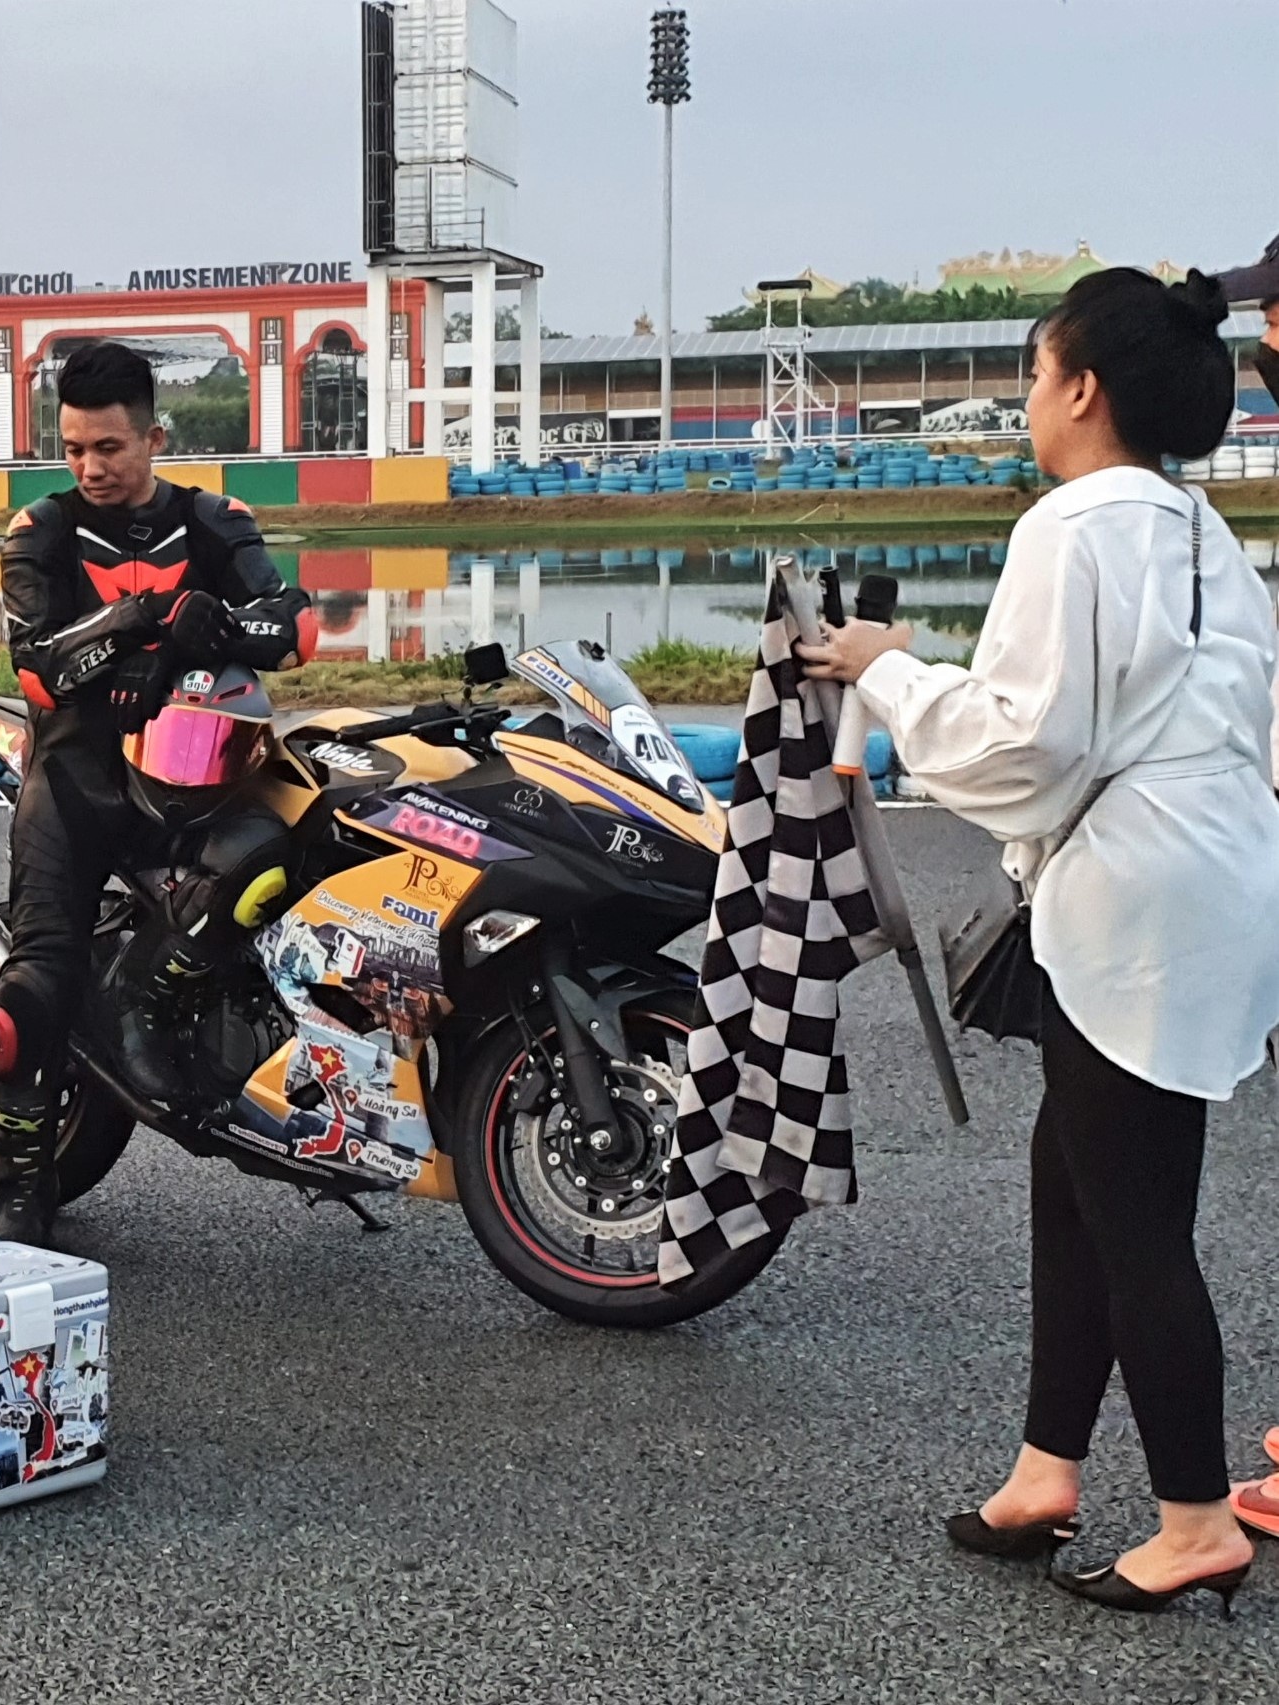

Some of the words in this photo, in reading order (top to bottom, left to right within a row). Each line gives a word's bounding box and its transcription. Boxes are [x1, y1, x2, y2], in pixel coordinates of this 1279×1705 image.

[18, 271, 73, 294] CHƠI
[127, 264, 279, 291] AMUSEMENT
[288, 261, 352, 284] ZONE
[310, 742, 374, 771] Ninja
[401, 792, 489, 830] AWAKENING
[390, 807, 480, 859] ROAD
[317, 889, 359, 920] Discovery
[382, 895, 438, 930] Fami
[402, 1105, 417, 1118] Sa
[404, 1164, 419, 1177] Sa
